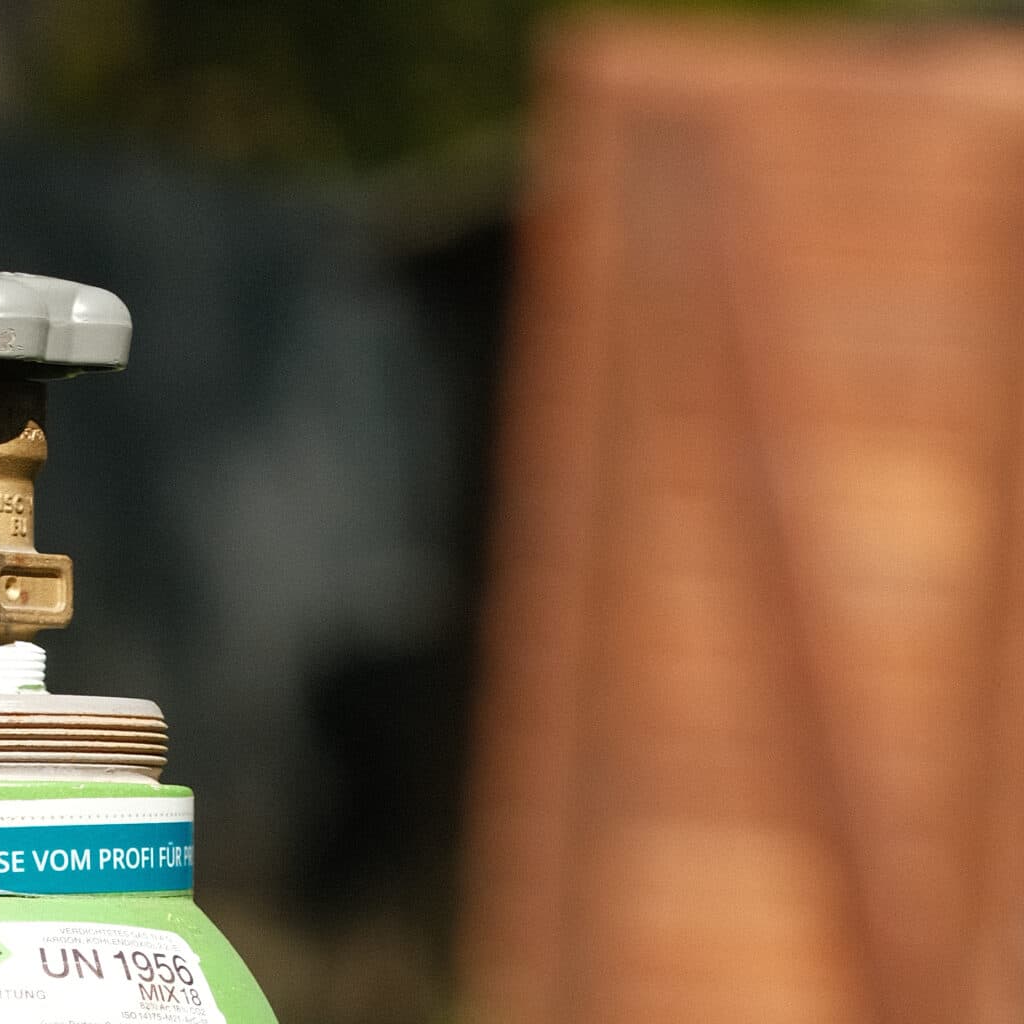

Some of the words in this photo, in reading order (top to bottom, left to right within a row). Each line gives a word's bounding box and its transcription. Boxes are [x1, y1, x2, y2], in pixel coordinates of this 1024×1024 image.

[31, 849, 92, 872] VOM
[99, 847, 154, 870] PROFI
[159, 841, 182, 868] FÜR
[39, 947, 105, 979] UN
[113, 950, 194, 985] 1956
[138, 983, 180, 1004] MIX
[180, 988, 202, 1006] 18
